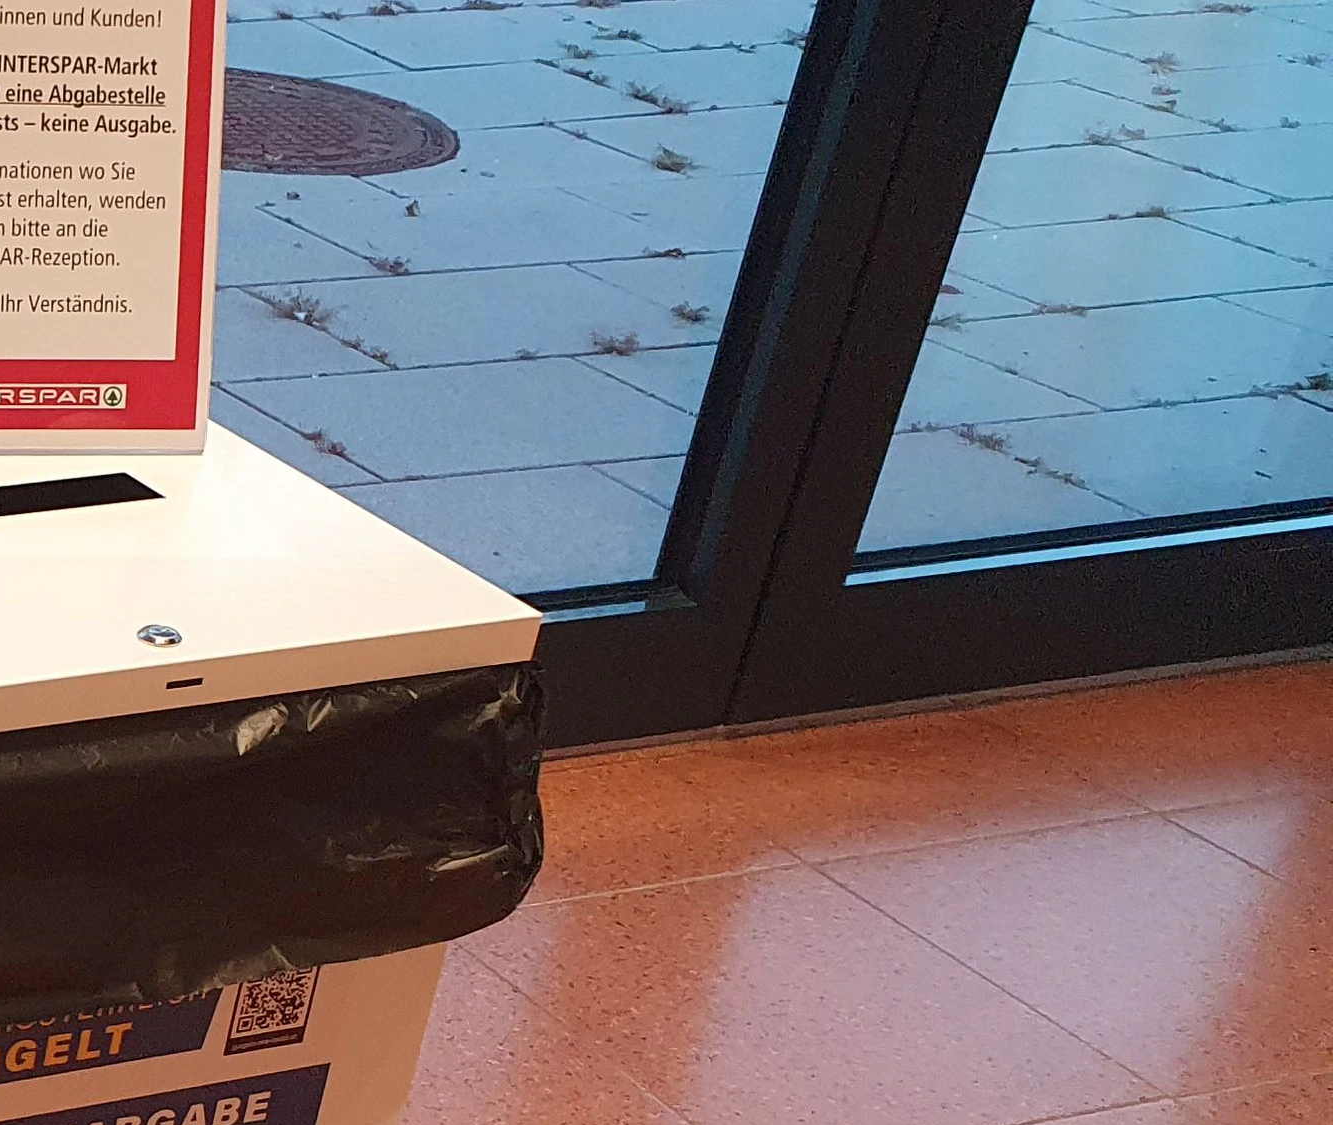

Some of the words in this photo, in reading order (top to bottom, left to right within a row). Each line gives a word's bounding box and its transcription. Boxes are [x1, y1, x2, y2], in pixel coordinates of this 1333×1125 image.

[53, 7, 84, 26] und
[91, 8, 161, 27] Kunden!
[5, 86, 43, 103] eine
[49, 86, 165, 108] Abgabestelle
[41, 112, 89, 132] keine
[94, 114, 176, 138] Ausgabe.
[79, 166, 104, 179] wo
[111, 162, 135, 180] Sie
[18, 188, 92, 211] erhalten,
[99, 190, 165, 209] wenden
[11, 217, 50, 237] bitte
[56, 223, 76, 237] an
[83, 218, 108, 237] die
[1, 293, 23, 312] Ihr
[28, 293, 132, 313] Verständnis.
